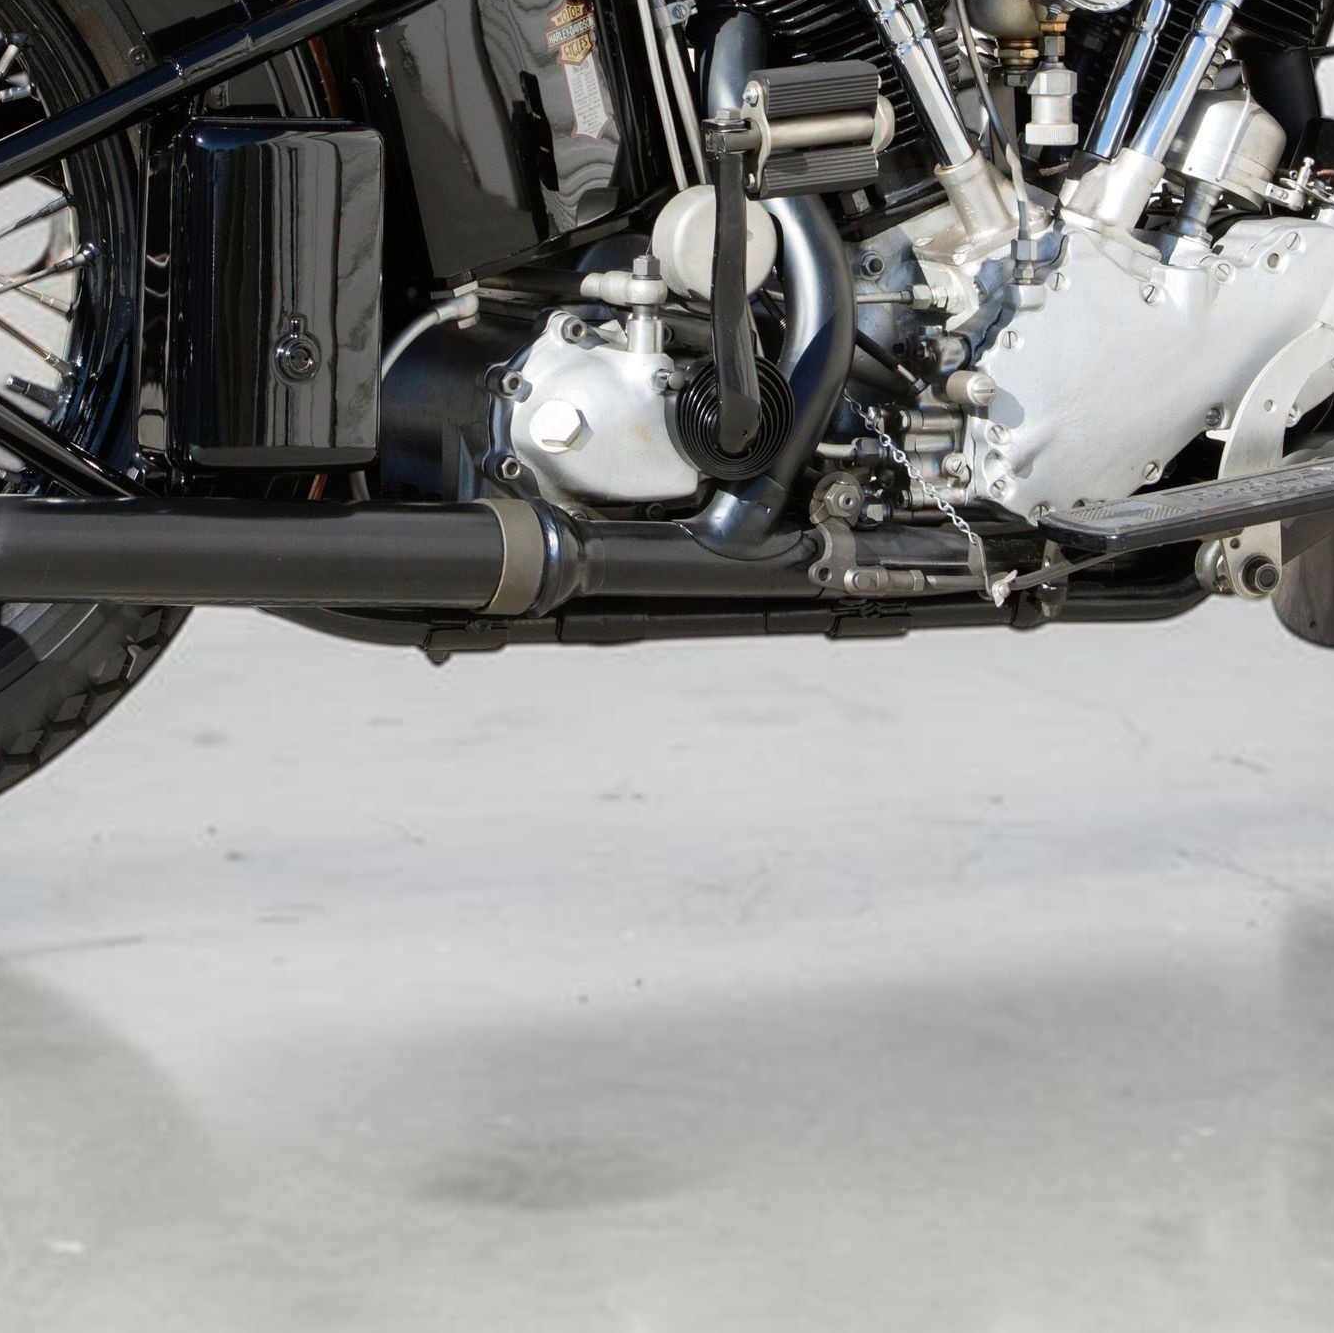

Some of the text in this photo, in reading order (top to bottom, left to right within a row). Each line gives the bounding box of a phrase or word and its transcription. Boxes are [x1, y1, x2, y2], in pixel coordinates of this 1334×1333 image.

[555, 6, 582, 25] MOTOR
[548, 15, 595, 45] HARLEY-DAVIDSON
[563, 36, 588, 58] CYCLES
